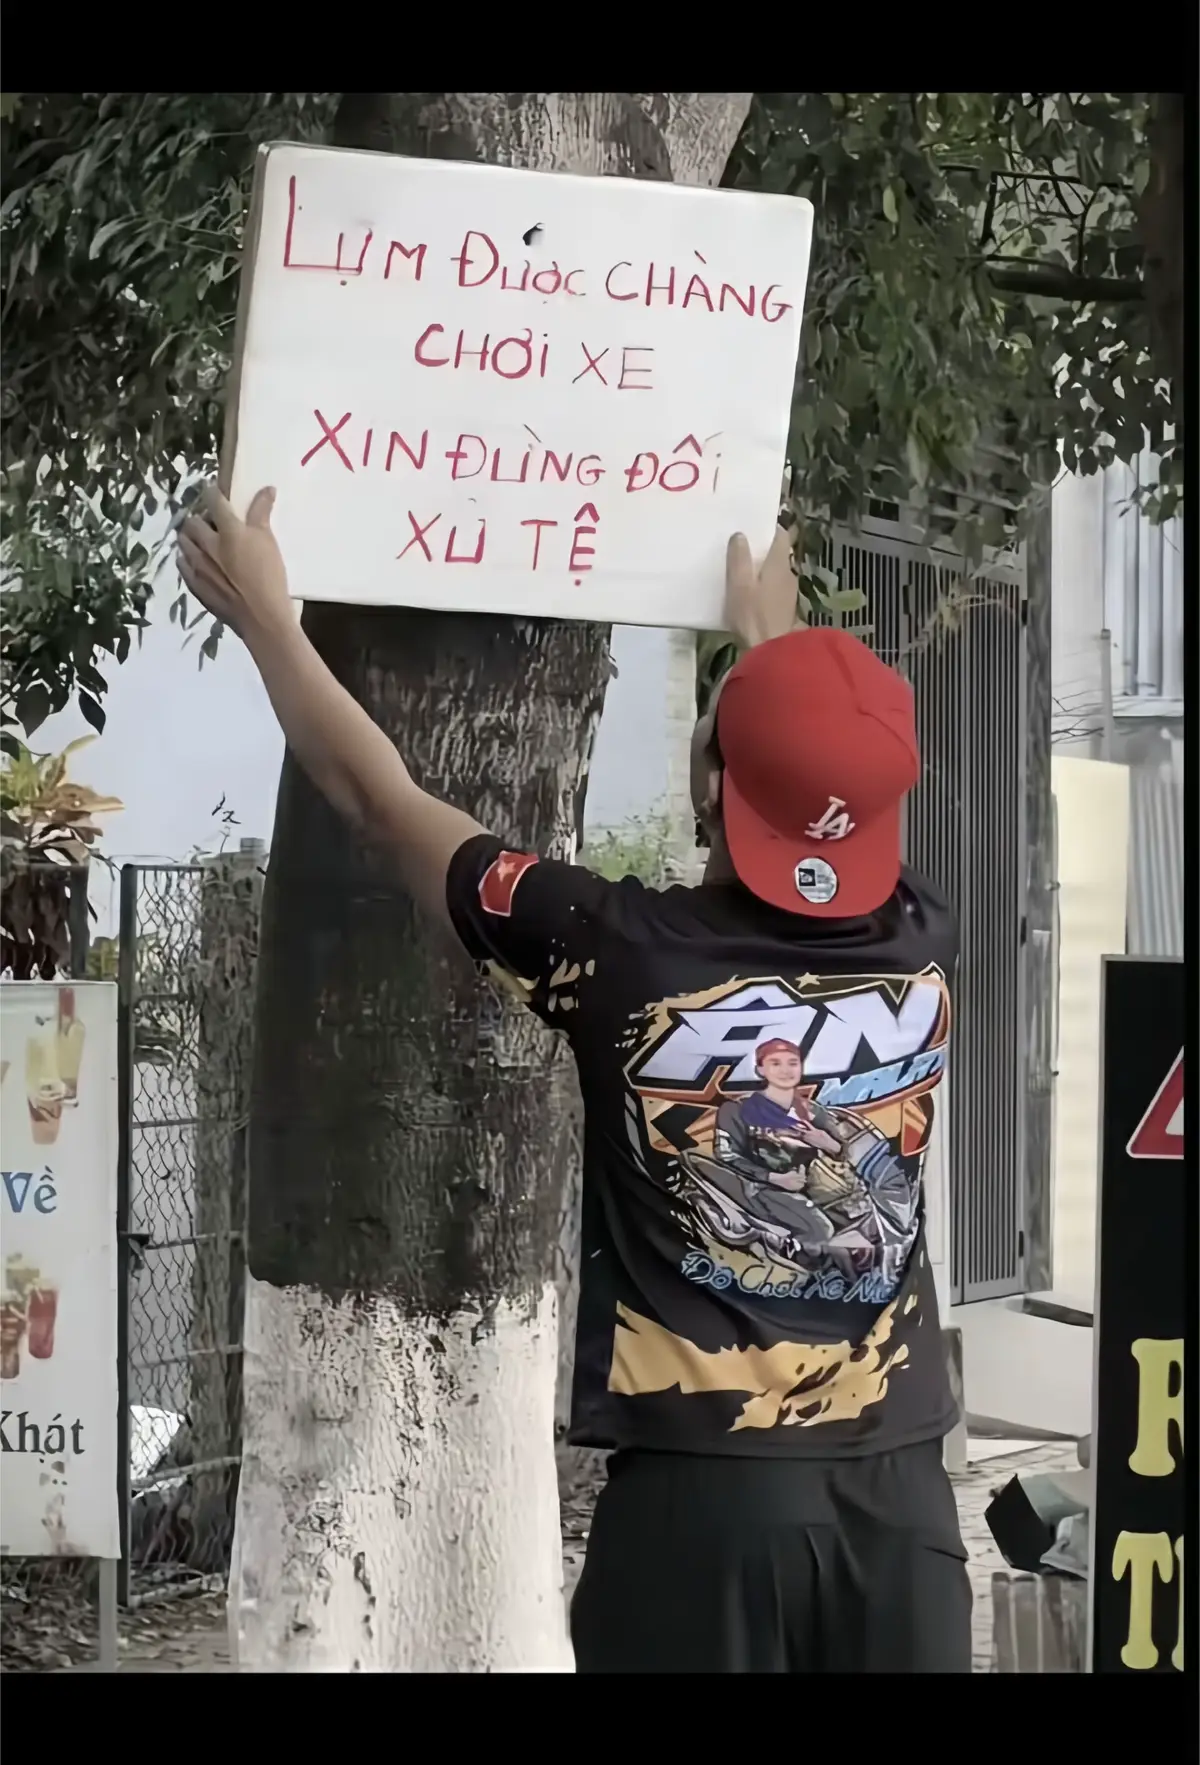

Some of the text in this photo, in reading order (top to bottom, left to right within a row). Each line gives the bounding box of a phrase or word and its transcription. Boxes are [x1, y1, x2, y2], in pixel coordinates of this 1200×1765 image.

[605, 250, 793, 323] CHÀNG
[572, 342, 655, 389] XE
[300, 409, 429, 473] XIN
[445, 424, 606, 486] ĐỪNG
[520, 502, 600, 587] TỆ
[804, 795, 856, 840] LA
[0, 1165, 57, 1214] Về
[1112, 1530, 1184, 1672] T
